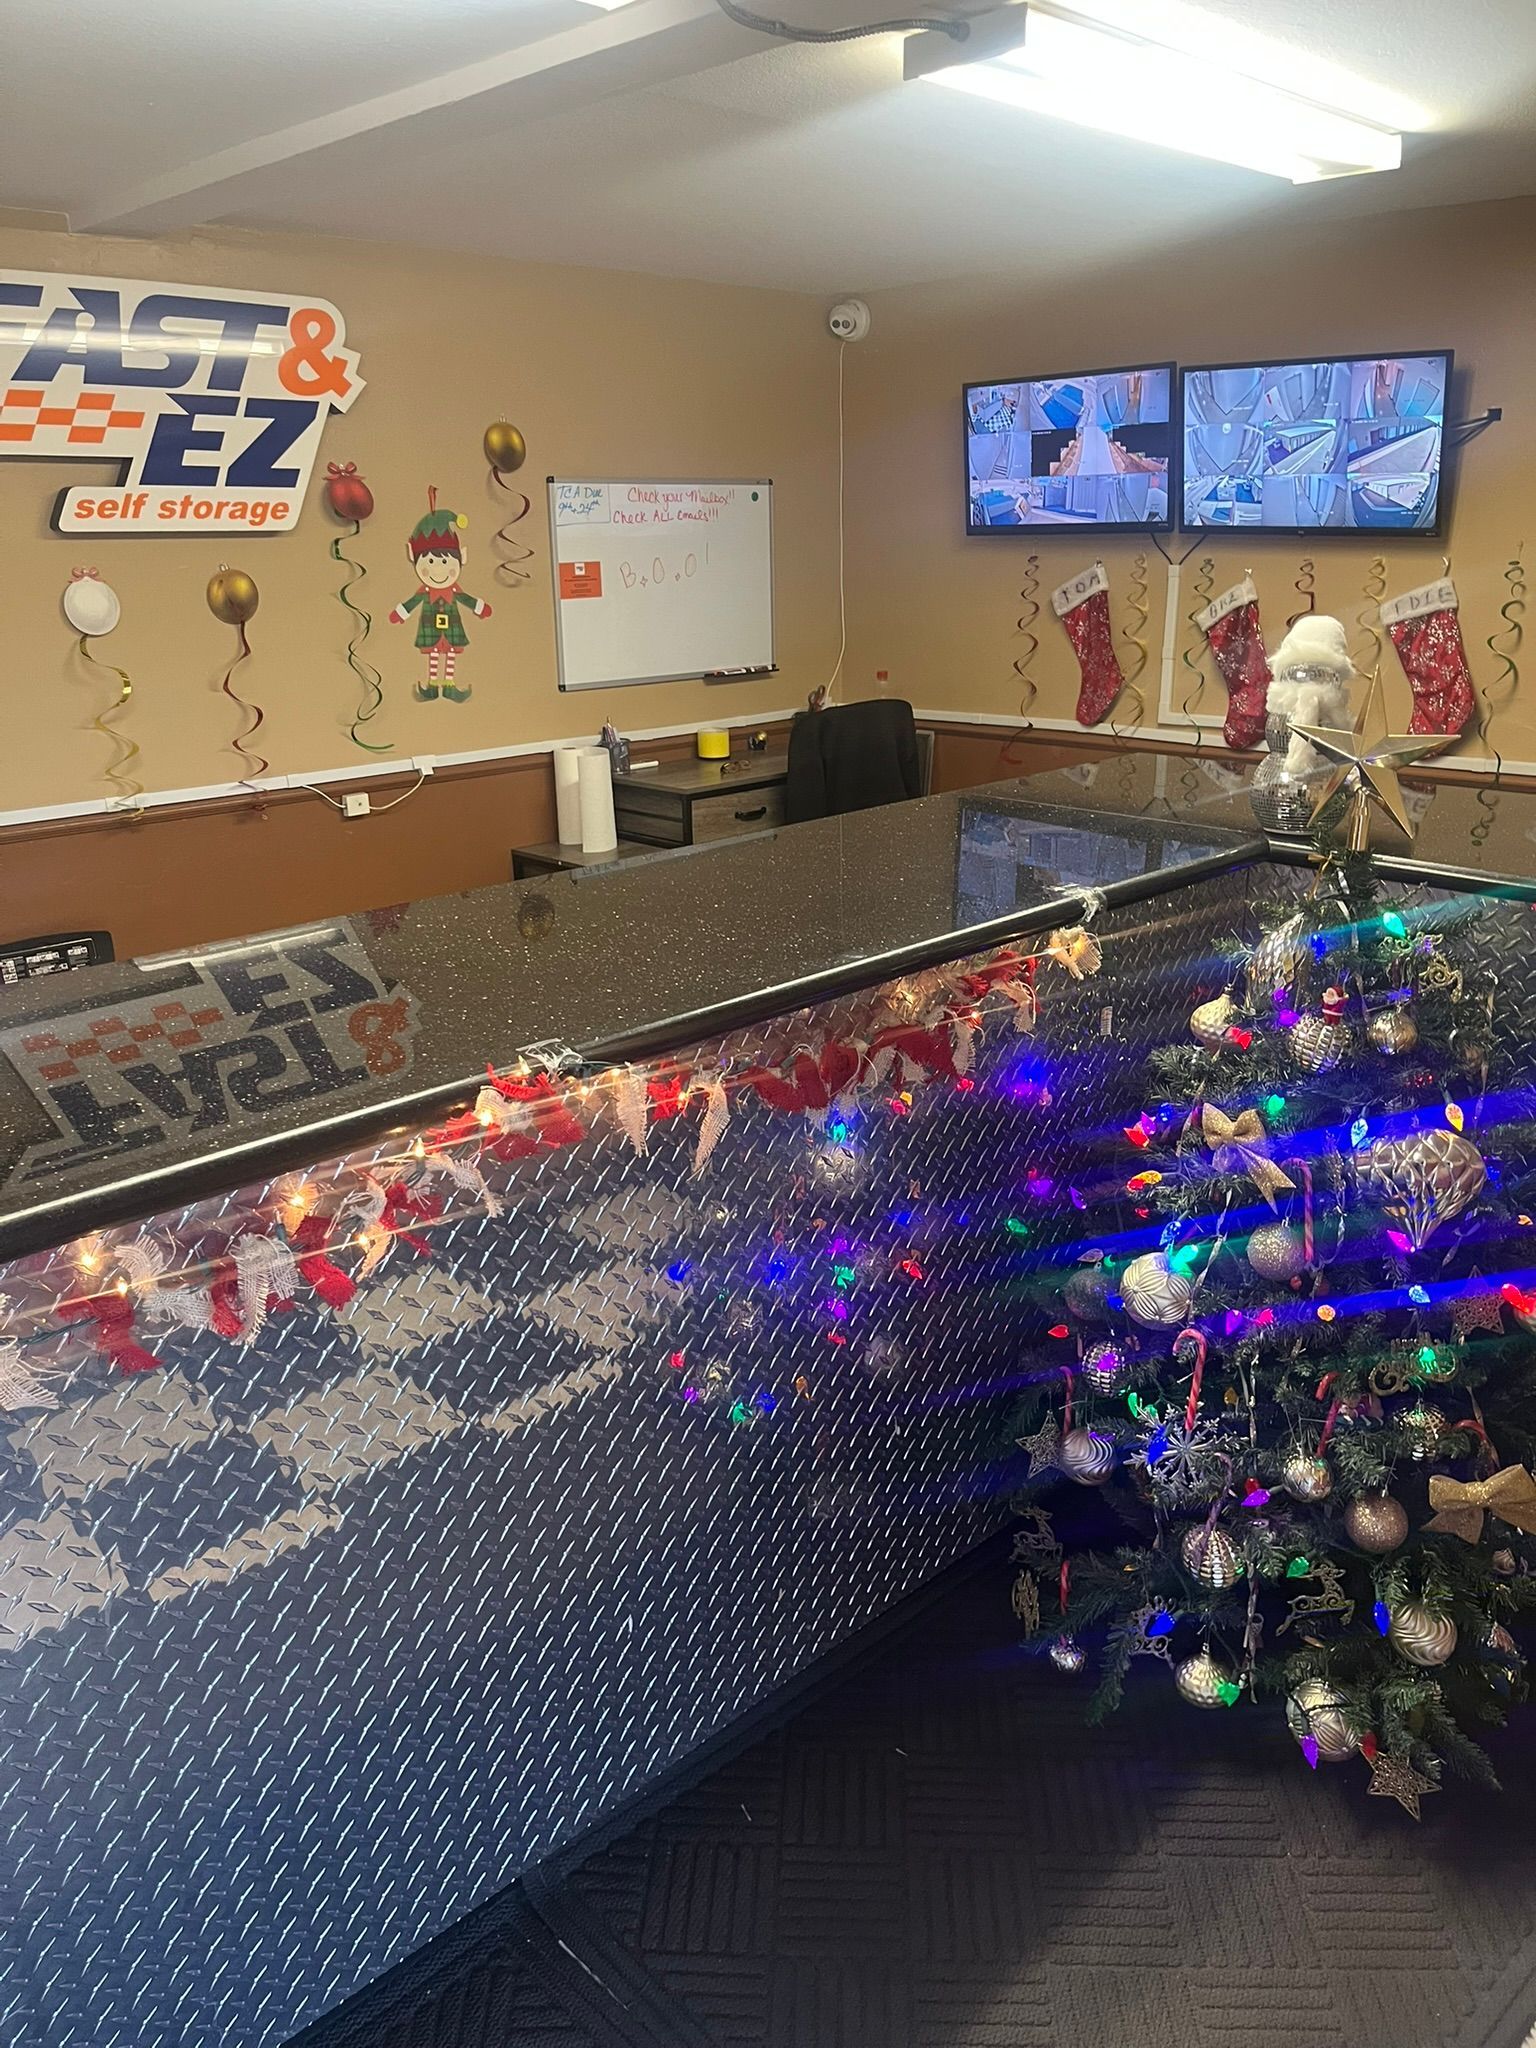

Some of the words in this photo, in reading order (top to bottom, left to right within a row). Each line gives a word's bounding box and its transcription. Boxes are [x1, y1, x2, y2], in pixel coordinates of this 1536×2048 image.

[278, 308, 352, 398] &
[139, 393, 320, 488] EZ
[74, 493, 149, 519] self
[158, 495, 289, 526] storage
[627, 487, 660, 503] Check
[662, 491, 684, 512] your
[613, 510, 647, 524] Check
